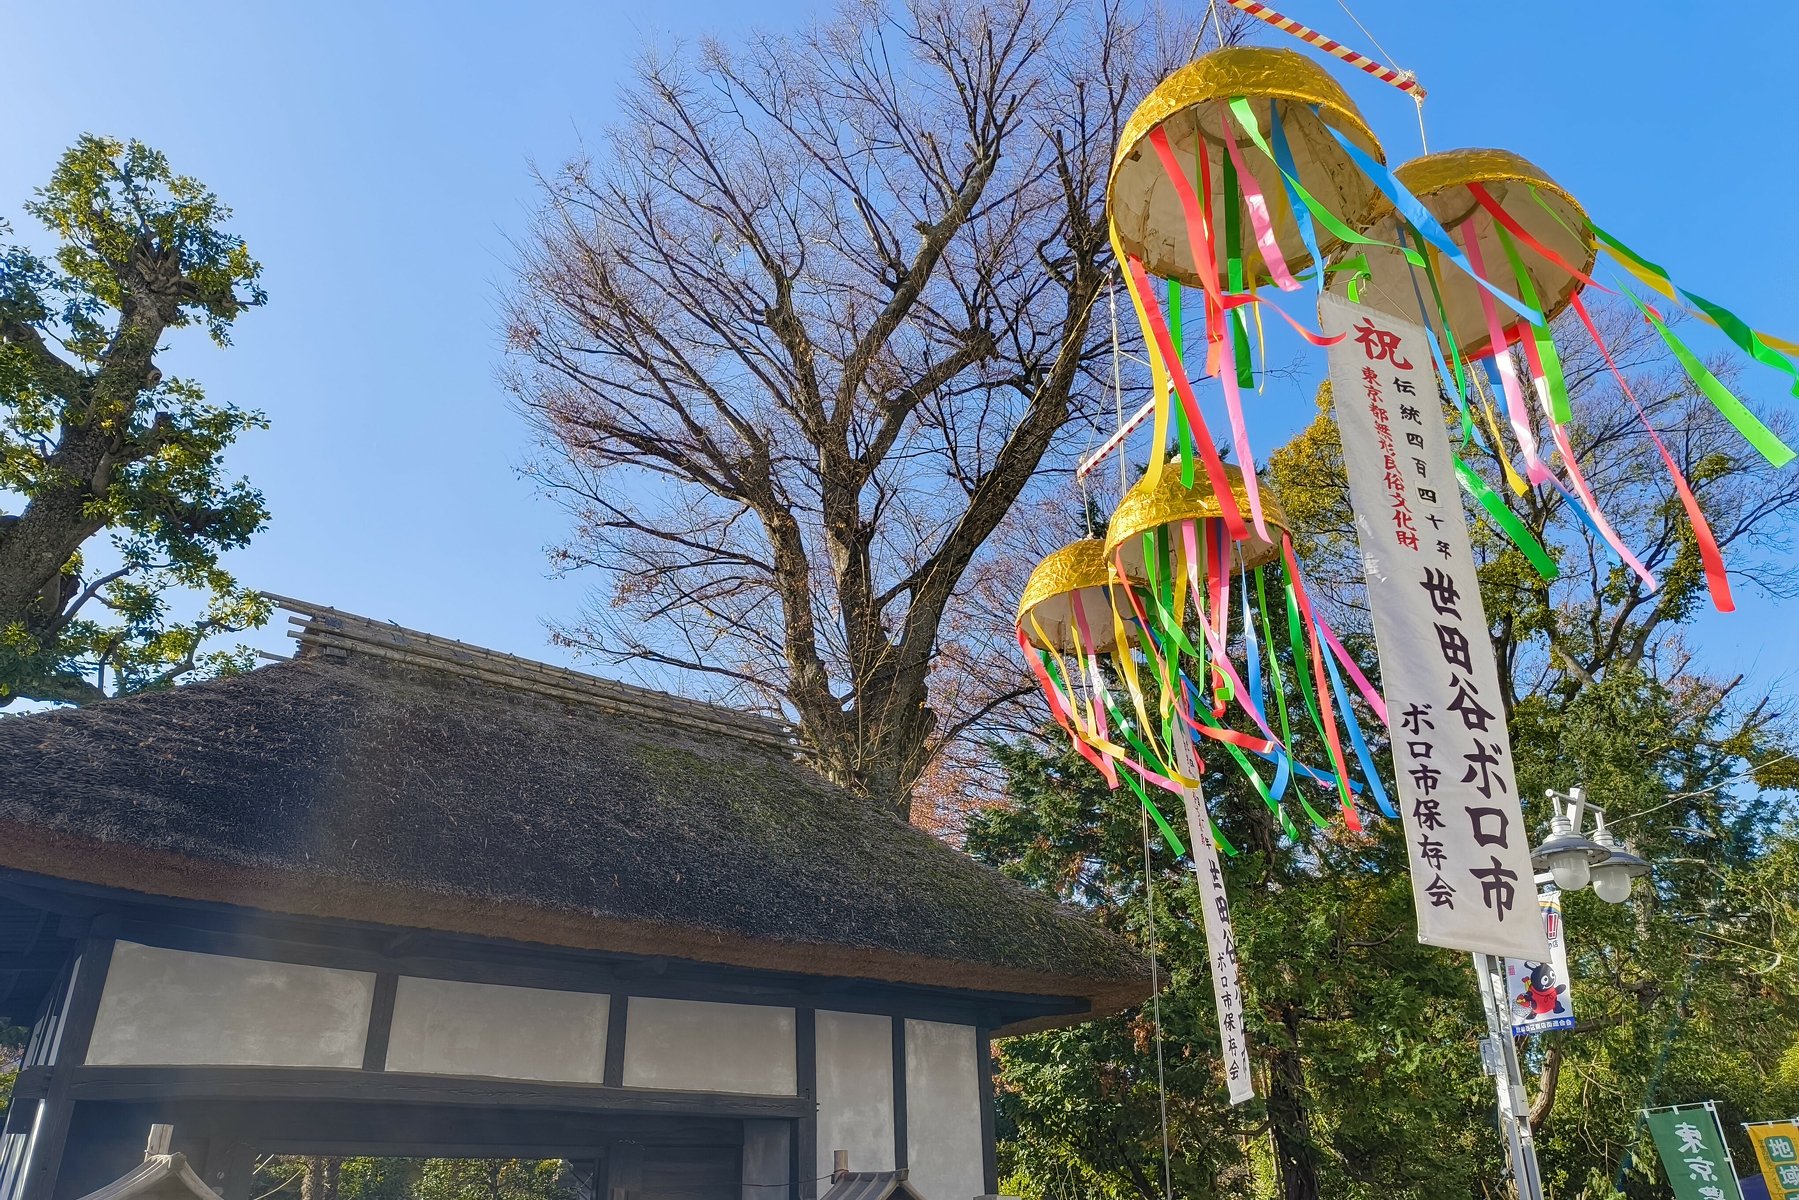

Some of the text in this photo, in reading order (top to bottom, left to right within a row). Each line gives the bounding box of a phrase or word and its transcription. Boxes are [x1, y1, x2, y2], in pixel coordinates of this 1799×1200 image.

[1353, 316, 1414, 371] 祝
[1361, 366, 1420, 552] 東京都無形民俗文化財
[1391, 376, 1453, 561] 伝統四百四十年
[1400, 702, 1457, 910] ボロ市保存会
[1419, 567, 1518, 923] 世田谷ボロ市
[1217, 951, 1240, 1081] ボロ市保存会
[1768, 1138, 1799, 1200] 地域
